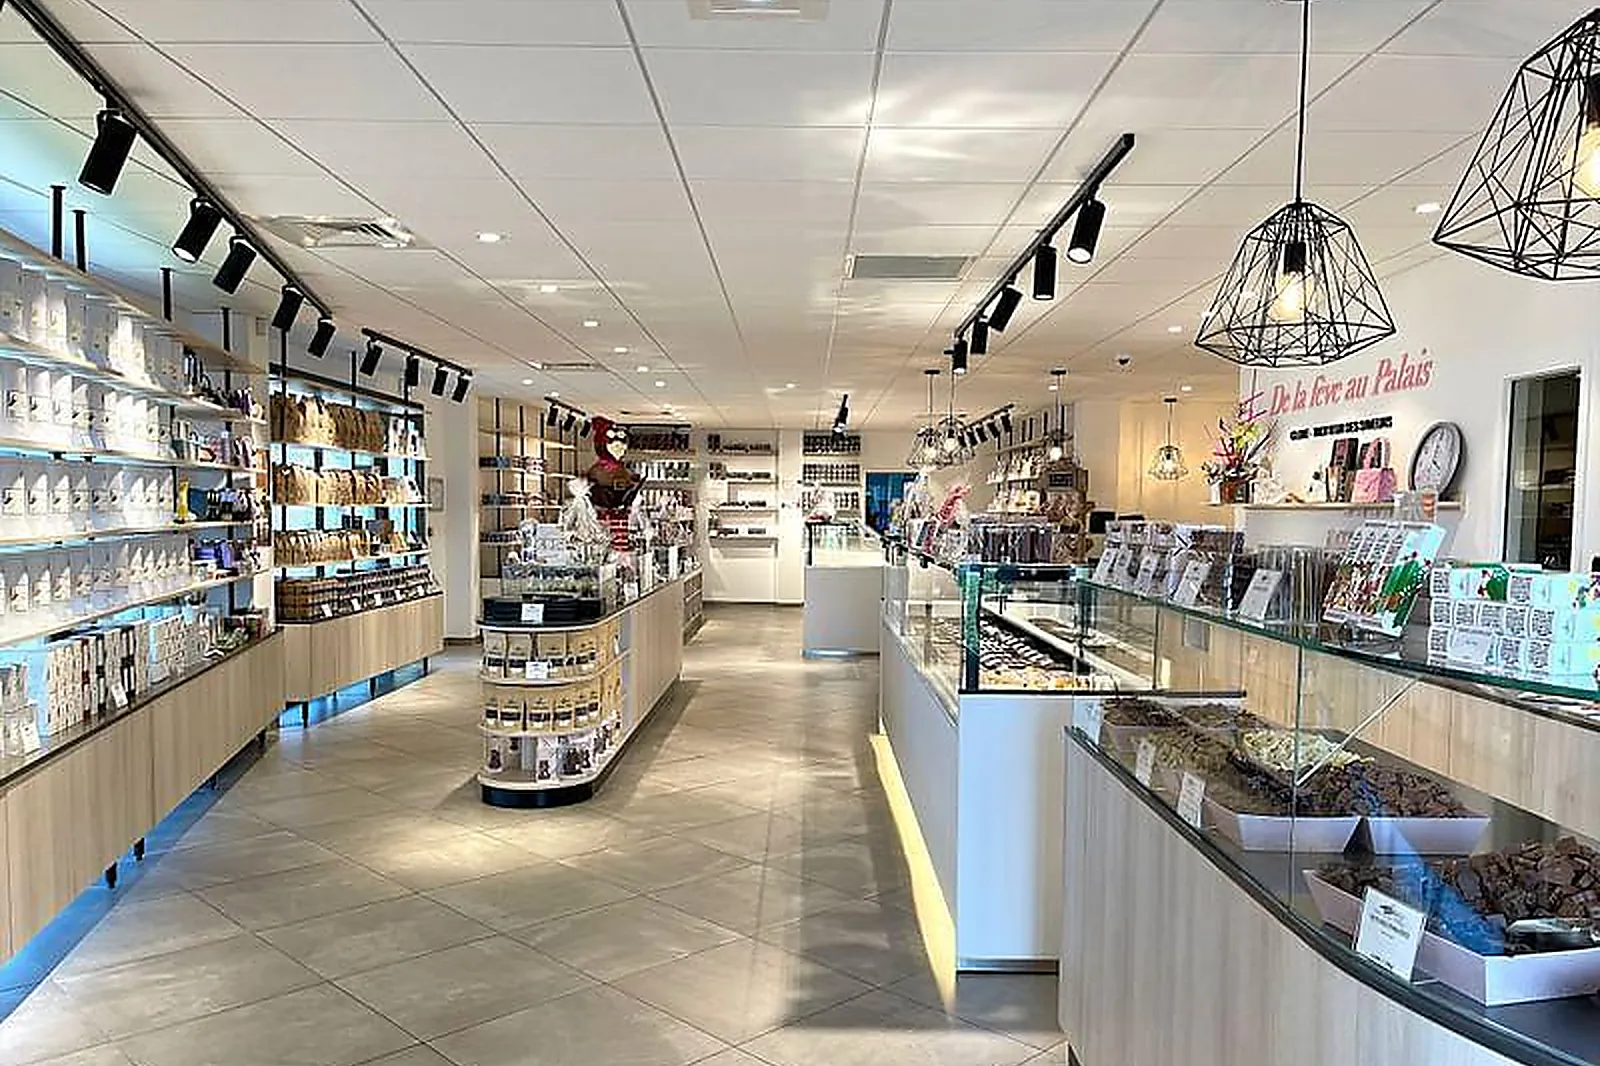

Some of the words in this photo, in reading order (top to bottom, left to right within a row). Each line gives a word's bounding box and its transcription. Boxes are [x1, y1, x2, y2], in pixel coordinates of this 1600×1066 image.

[1270, 384, 1290, 416] De
[1292, 379, 1307, 412] la
[1345, 374, 1369, 401] au
[1371, 348, 1433, 396] Palais
